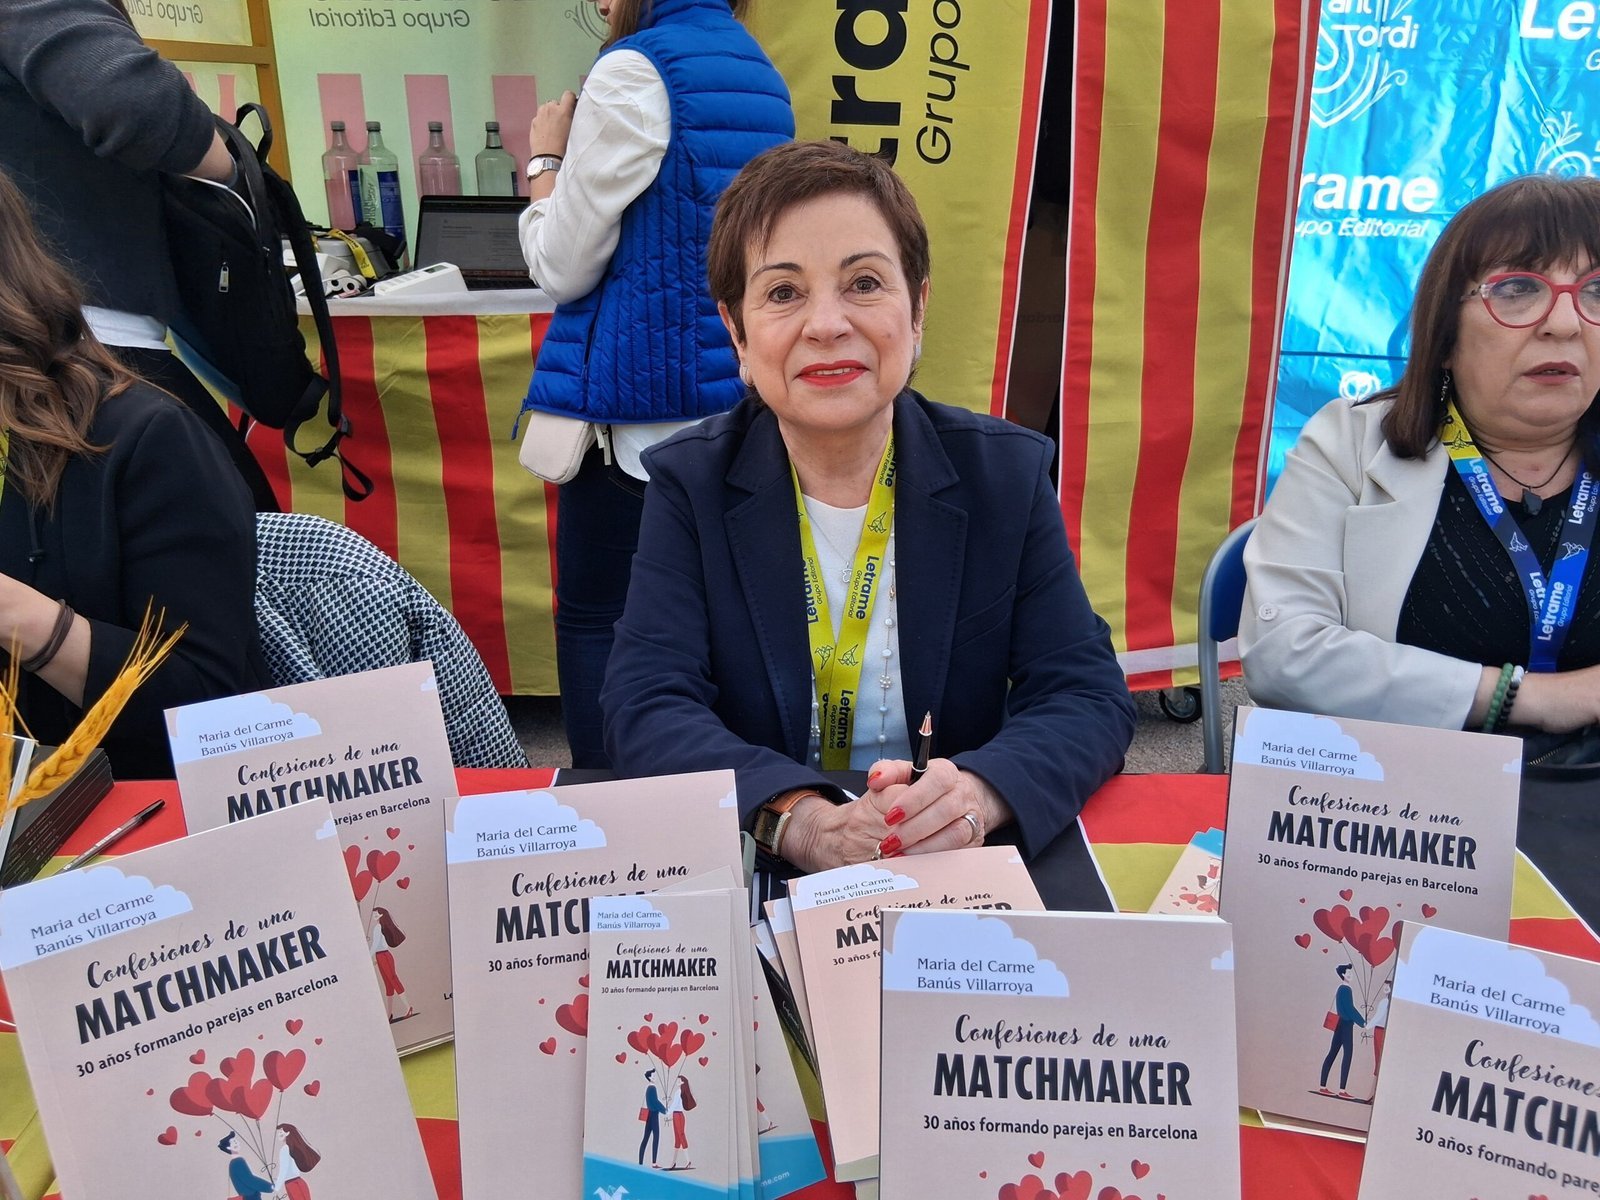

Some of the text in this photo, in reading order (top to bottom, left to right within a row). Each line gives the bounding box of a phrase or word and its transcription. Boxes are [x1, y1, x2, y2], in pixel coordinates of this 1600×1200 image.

[916, 0, 970, 164] Grupo
[1338, 218, 1429, 238] Editorial
[1469, 458, 1503, 515] Letrame
[1568, 472, 1593, 526] Letrame
[855, 555, 880, 620] Letrame
[1537, 581, 1565, 641] Letrame
[198, 717, 294, 745] Maria del Carme
[837, 689, 854, 749] Letrame
[201, 730, 294, 757] Banús Villarroya
[1262, 741, 1358, 762] Maria del Carme
[237, 741, 401, 787] Confesiones de una
[1260, 754, 1355, 776] Banús Villarroya
[227, 756, 424, 823] MATCHMAKER
[365, 807, 379, 818] en
[380, 796, 431, 815] Barcelona
[1288, 784, 1464, 827] Confesiones de una
[476, 823, 578, 843] Maria del Carme
[477, 837, 577, 859] Banús Villarroya
[1267, 810, 1478, 870] MATCHMAKER
[511, 871, 620, 898] Confesiones
[627, 863, 648, 882] de
[656, 863, 691, 879] una
[814, 877, 894, 898] Maria del Carme
[1257, 853, 1479, 896] 30 años formando parejas en Barcelona
[815, 885, 895, 906] Banús Villarroya
[940, 894, 959, 906] de
[965, 892, 994, 902] una
[30, 893, 155, 940] Maria del Carme
[597, 910, 663, 920] Maria del Carme
[597, 921, 661, 931] Banús Villarroya
[35, 909, 158, 957] Banús Villarroya
[87, 909, 297, 989] Confesiones de una
[616, 942, 709, 958] Confesiones de una
[488, 949, 590, 972] 30 años formand
[606, 957, 718, 980] MATCHMAKER
[832, 956, 845, 966] 30
[847, 951, 871, 963] años
[917, 957, 1036, 974] Maria del Carme
[75, 924, 328, 1045] MATCHMAKER
[601, 986, 610, 995] 30
[610, 984, 625, 995] años
[625, 984, 657, 994] formando
[657, 985, 680, 995] parejas
[689, 983, 720, 993] Barcelona
[917, 975, 1034, 995] Banús Villarroya
[1433, 974, 1567, 1017] Maria del Carme
[76, 973, 339, 1078] 30 años formando parejas en Barcelona
[955, 1013, 1171, 1049] Confesiones de una
[1430, 992, 1561, 1035] Banús Villarroya
[933, 1052, 1193, 1107] MATCHMAKER
[923, 1115, 1199, 1141] 30 años formando parejas en Barcelona
[1416, 1127, 1434, 1144] 30
[1437, 1135, 1474, 1156] años
[1477, 1144, 1558, 1180] formando
